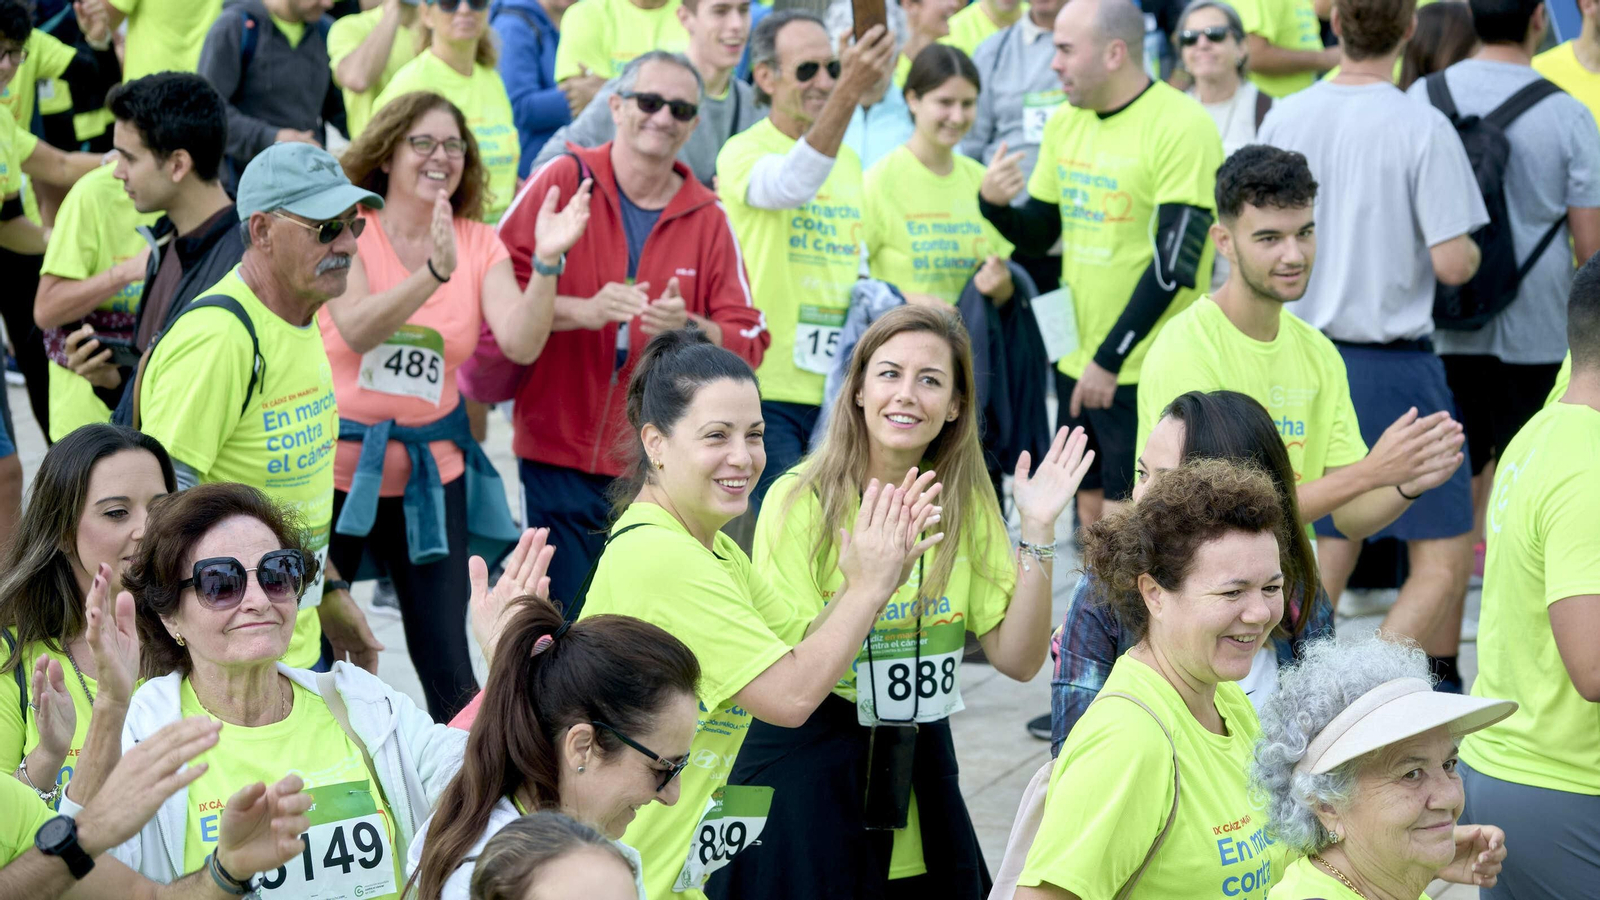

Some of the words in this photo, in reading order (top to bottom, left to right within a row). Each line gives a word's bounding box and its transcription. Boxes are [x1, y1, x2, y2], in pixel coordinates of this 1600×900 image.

[383, 347, 440, 385] 485
[262, 410, 292, 433] En
[265, 422, 323, 452] contra
[266, 453, 291, 474] el
[880, 595, 951, 621] archa
[900, 637, 929, 648] cáner
[887, 657, 955, 701] 888
[1217, 836, 1253, 867] En
